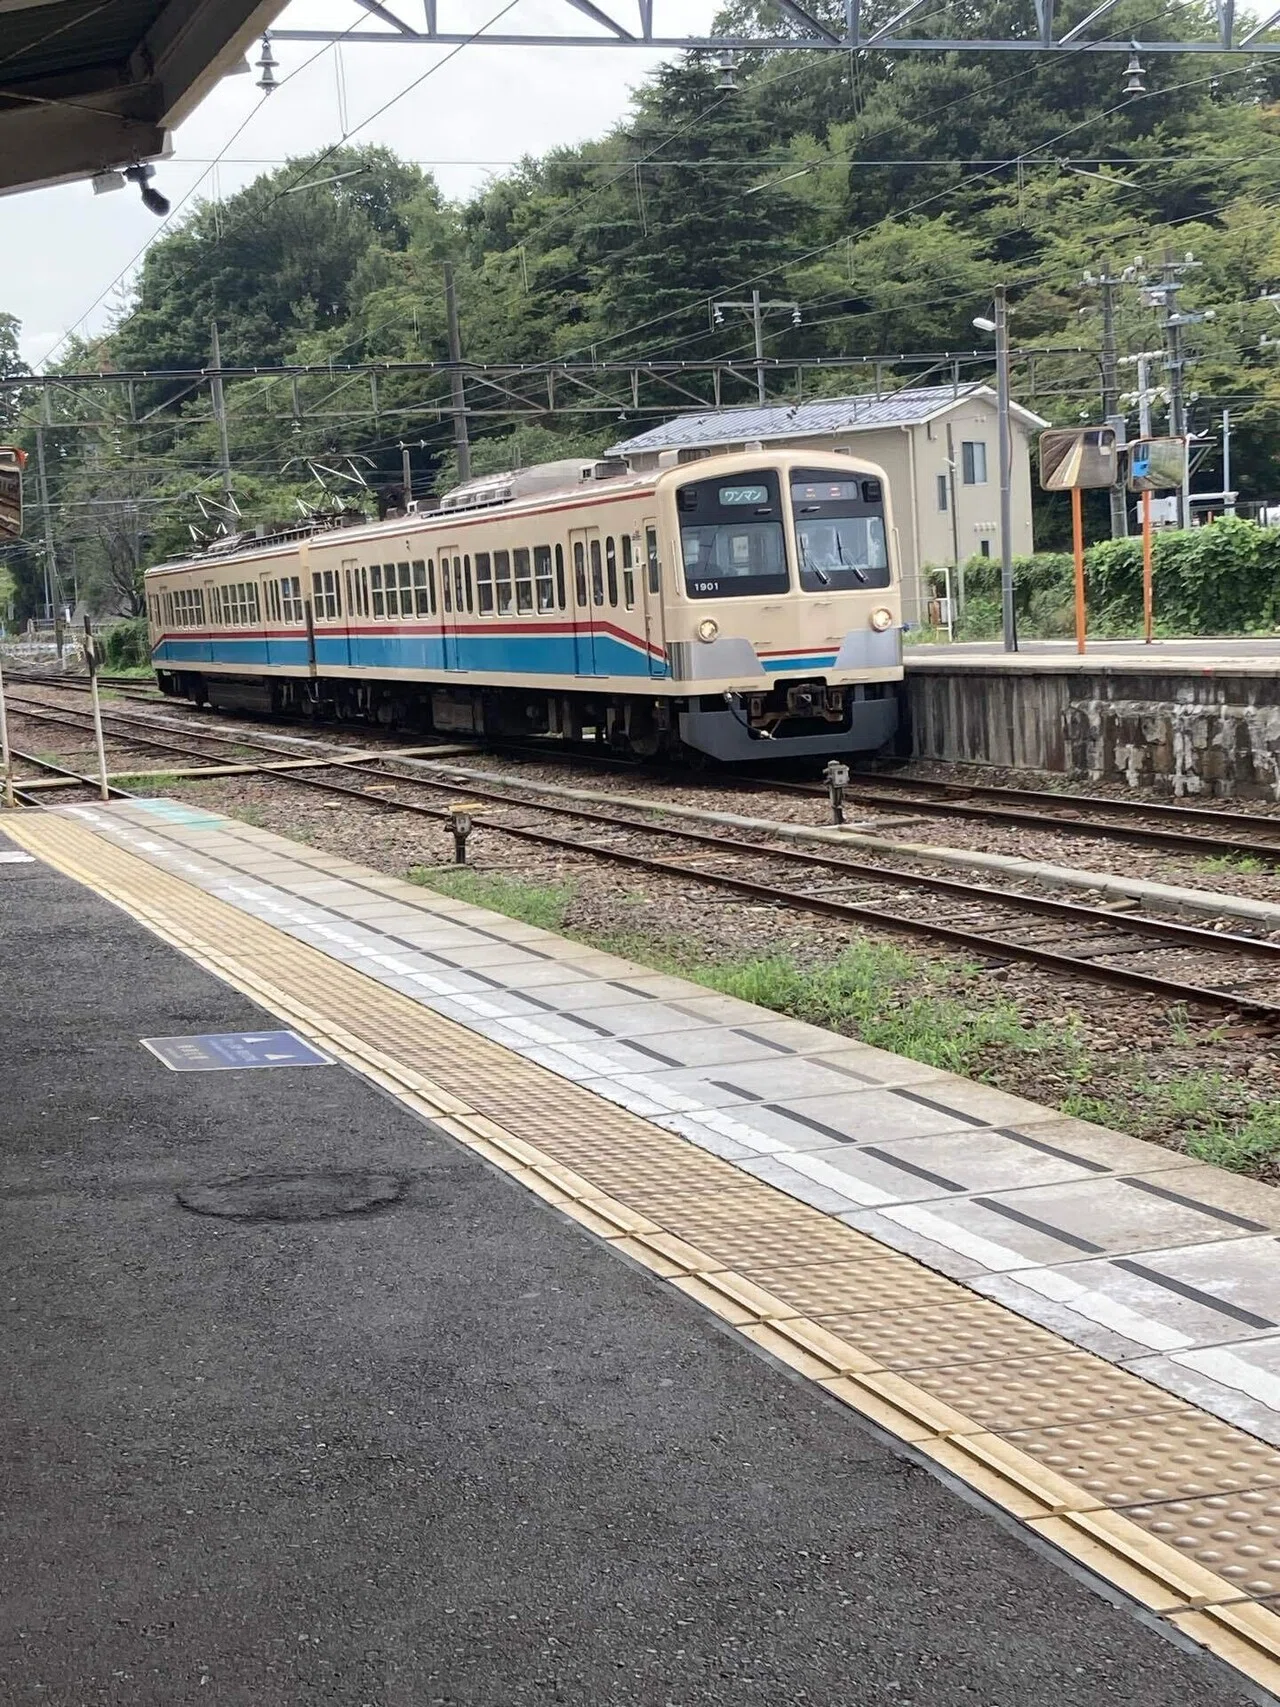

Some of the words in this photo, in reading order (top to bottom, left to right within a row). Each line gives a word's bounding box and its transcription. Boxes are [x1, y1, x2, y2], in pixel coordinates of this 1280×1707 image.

[725, 490, 761, 502] ワンマン
[694, 582, 719, 591] 1901
